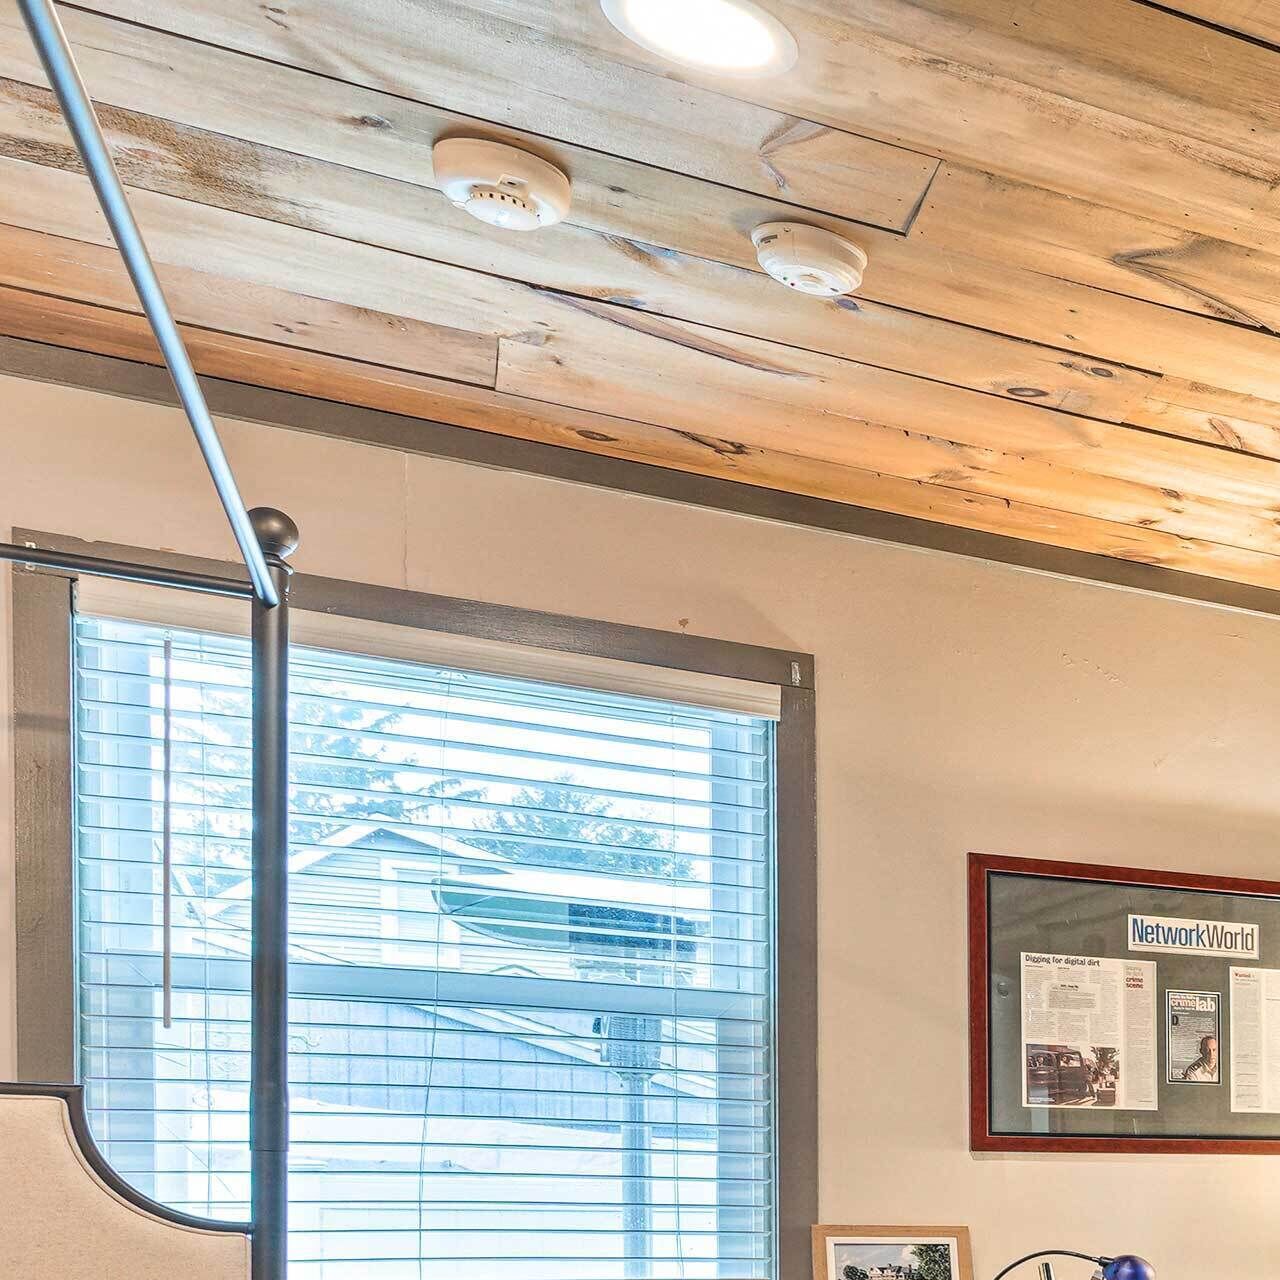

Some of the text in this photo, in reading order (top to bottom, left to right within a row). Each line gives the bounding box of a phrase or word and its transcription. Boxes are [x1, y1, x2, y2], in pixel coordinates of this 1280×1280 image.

[1025, 954, 1101, 968] Digging for digital dirt
[1171, 998, 1196, 1008] crime
[1195, 996, 1216, 1013] lab
